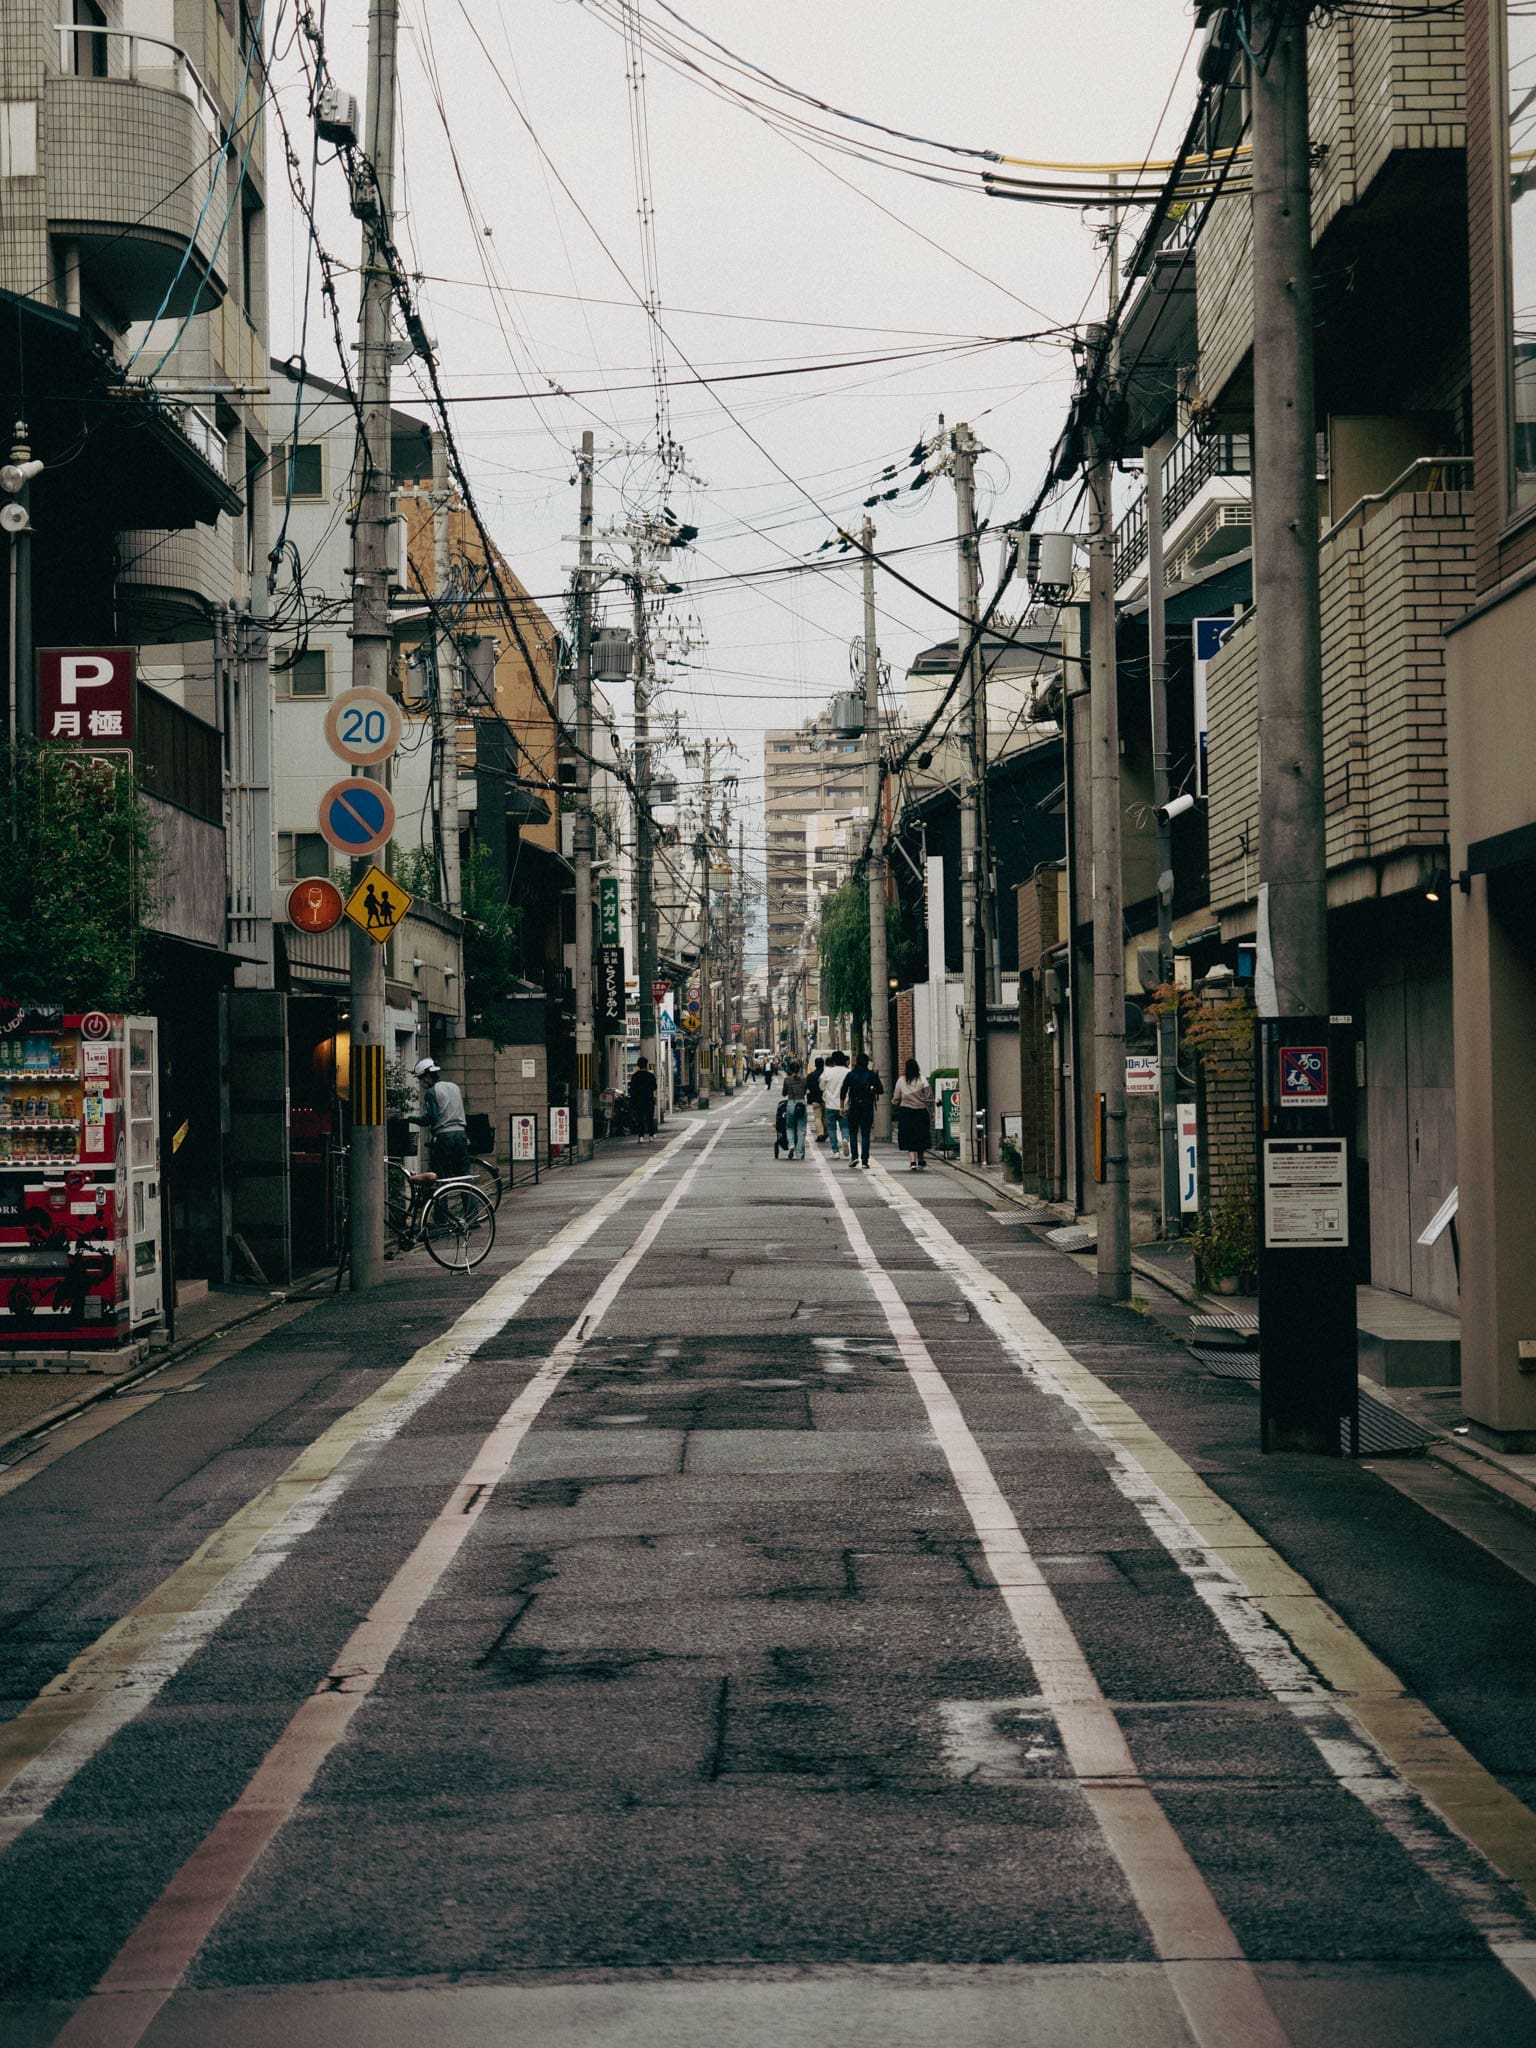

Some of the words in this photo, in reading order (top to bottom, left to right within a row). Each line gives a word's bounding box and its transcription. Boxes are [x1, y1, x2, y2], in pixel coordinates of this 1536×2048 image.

[60, 655, 114, 705] P
[50, 709, 123, 737] 月極
[342, 708, 386, 744] 20
[603, 887, 617, 935] メガネ
[0, 1205, 18, 1215] RK
